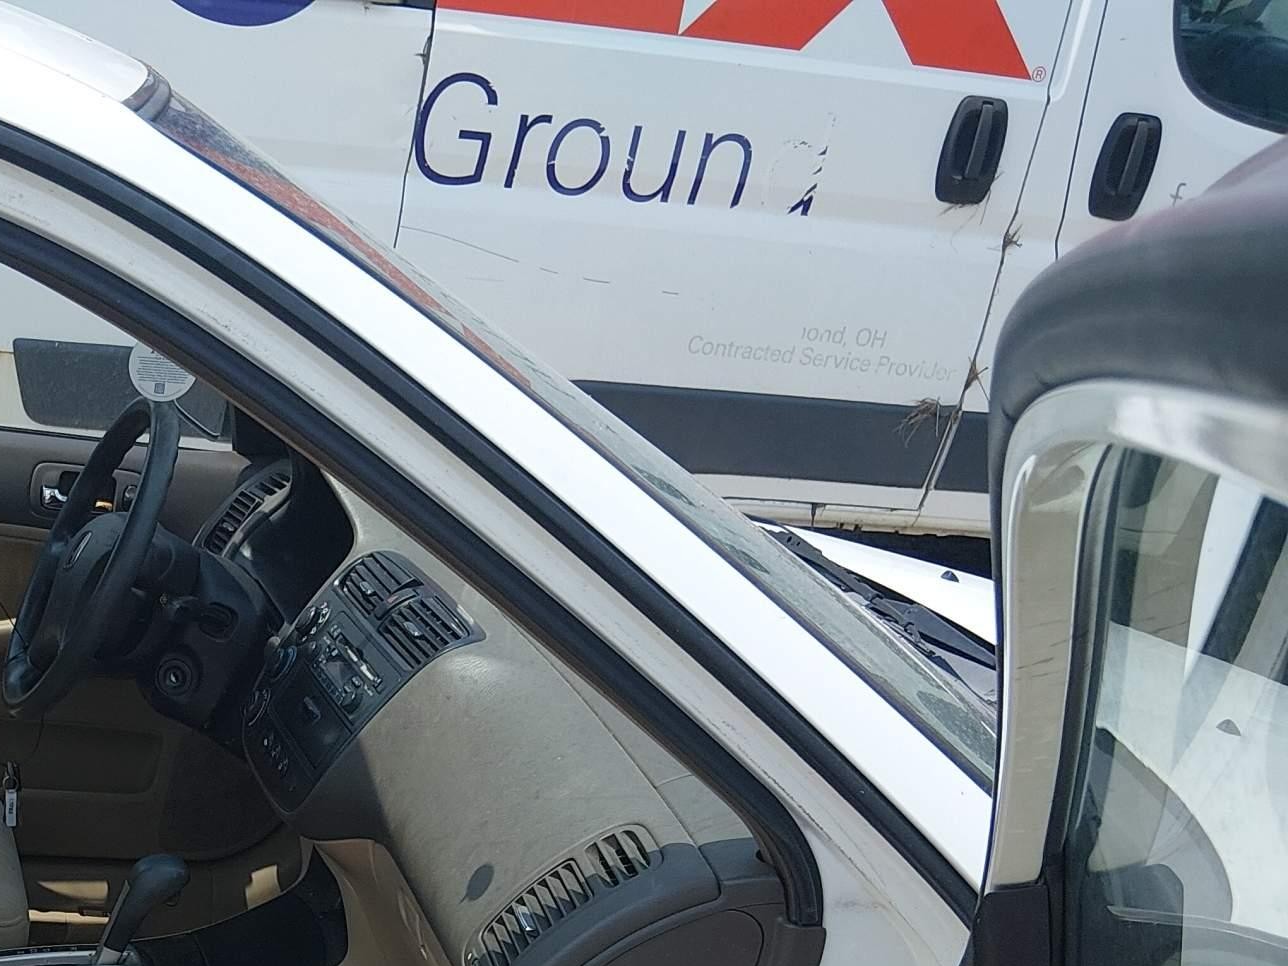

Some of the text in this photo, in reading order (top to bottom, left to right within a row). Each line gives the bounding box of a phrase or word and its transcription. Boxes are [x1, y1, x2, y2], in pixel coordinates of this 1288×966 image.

[855, 328, 888, 349] OH
[687, 335, 796, 365] Contracted
[799, 346, 872, 373] Service
